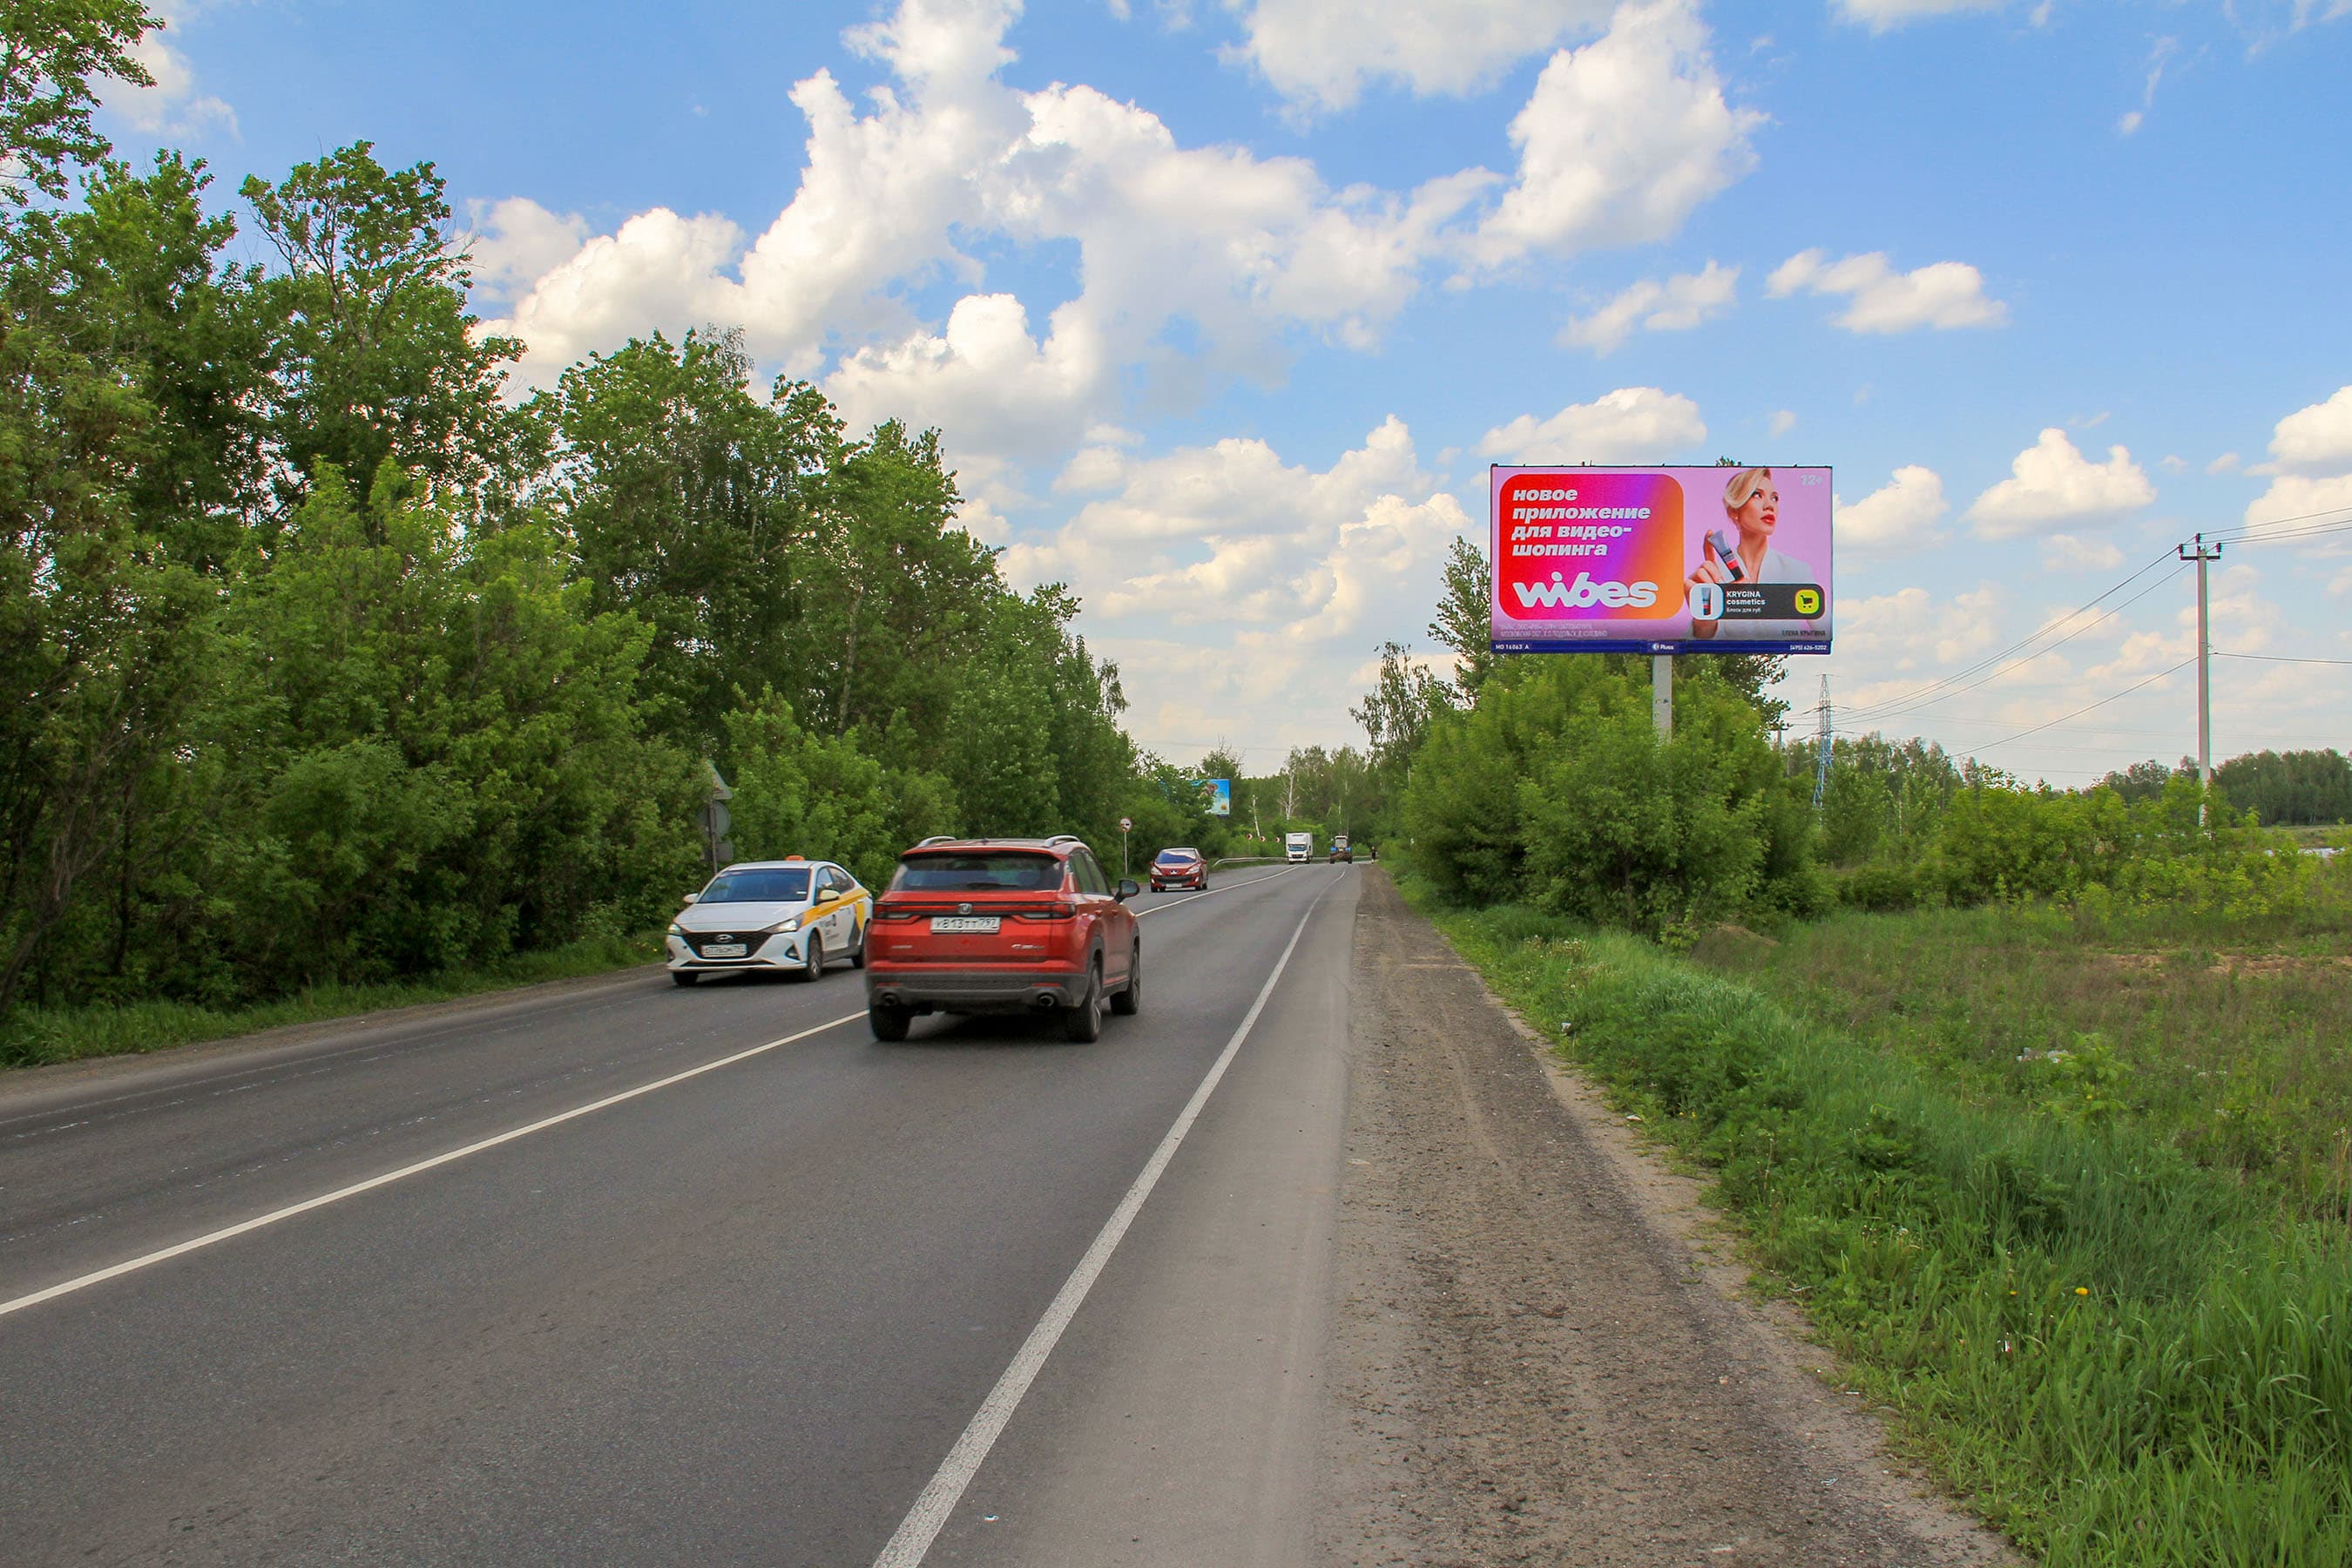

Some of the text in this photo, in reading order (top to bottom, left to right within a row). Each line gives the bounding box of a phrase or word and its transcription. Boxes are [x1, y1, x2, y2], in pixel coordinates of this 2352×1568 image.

[1512, 489, 1578, 501] новое
[1512, 507, 1652, 524] приложение
[1511, 525, 1632, 541] для видео-
[1512, 544, 1608, 557] шопинга
[1512, 571, 1659, 608] wibes
